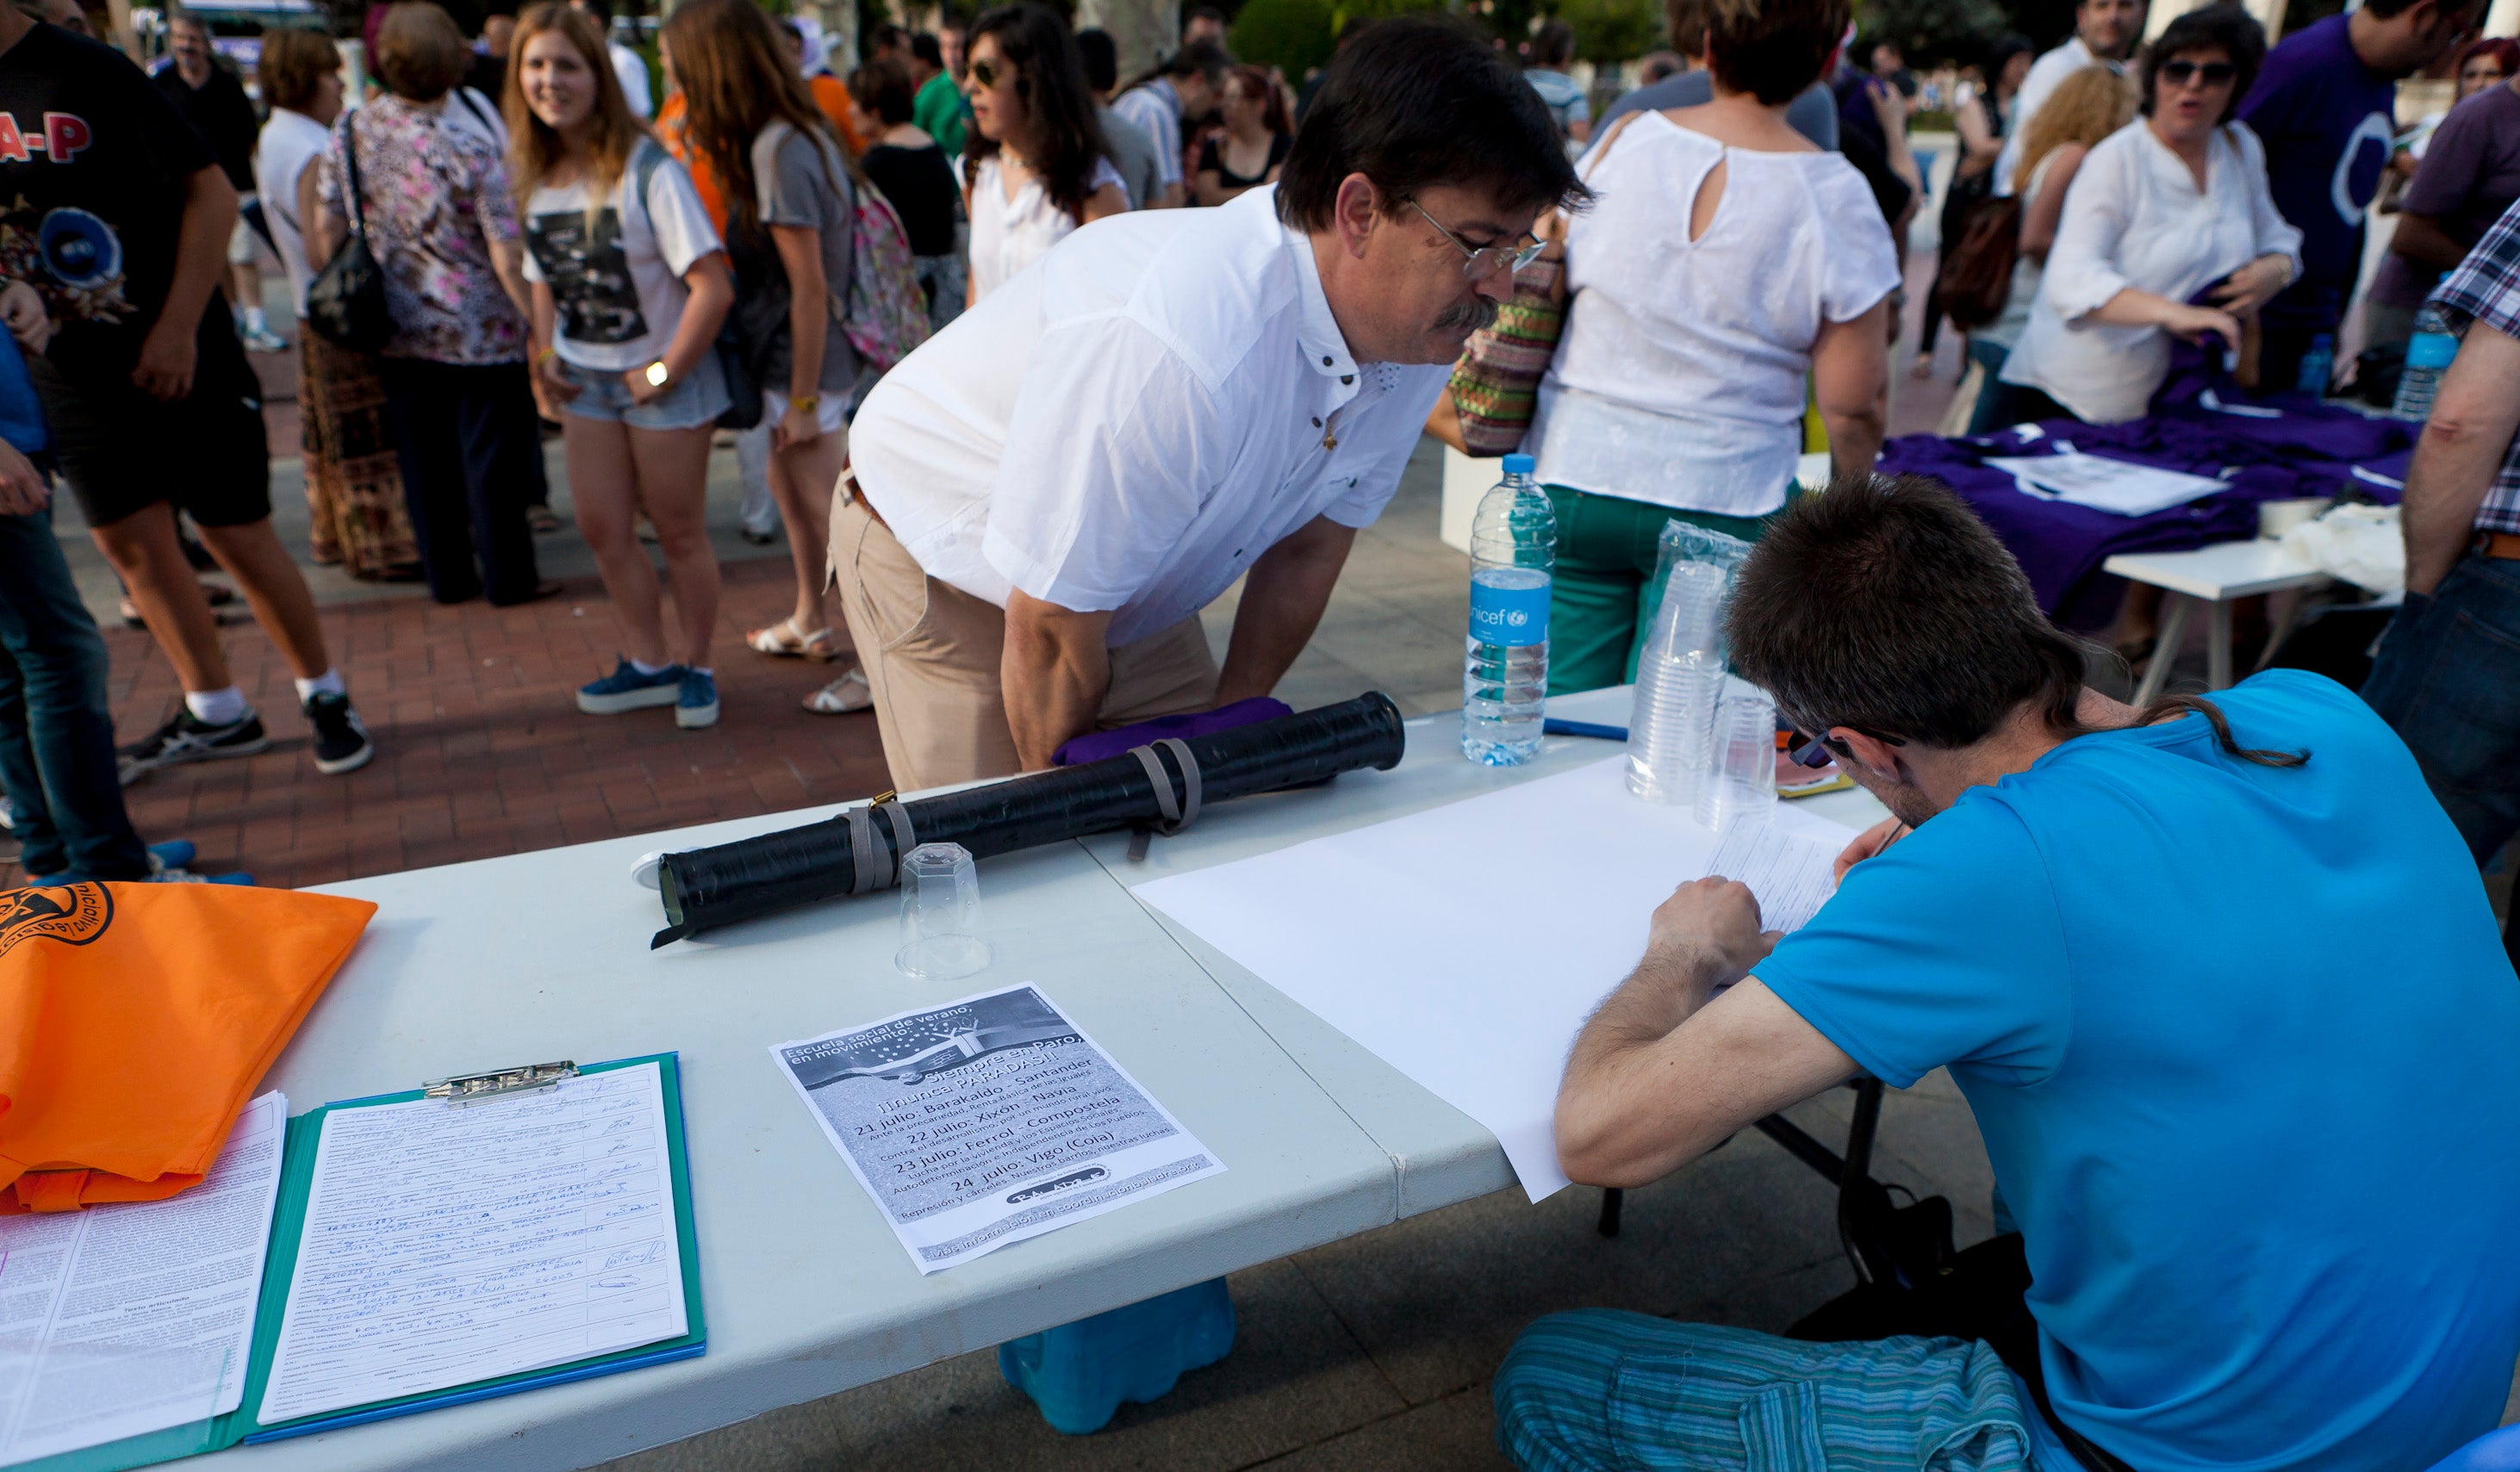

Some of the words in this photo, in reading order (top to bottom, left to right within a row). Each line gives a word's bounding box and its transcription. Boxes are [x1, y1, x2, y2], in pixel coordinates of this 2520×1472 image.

[786, 1040, 844, 1057] Escuela
[848, 1025, 890, 1042] social
[893, 1020, 913, 1028] de
[915, 1007, 972, 1022] verano,
[792, 1055, 812, 1064] en
[815, 1027, 914, 1058] movimiento:
[922, 1053, 1005, 1083] Siempre
[1005, 1047, 1030, 1058] en
[1032, 1033, 1084, 1051] Paro,
[854, 1124, 875, 1135] 21
[879, 1113, 921, 1129] julio:
[924, 1087, 1003, 1113] Barakaldo
[1014, 1059, 1091, 1085] Santander
[954, 1051, 1059, 1089] PARADAS!!
[869, 1130, 893, 1140] Ante
[906, 1108, 965, 1129] precariedad,
[968, 1099, 998, 1109] Renta
[999, 1088, 1029, 1101] Básica
[1057, 1070, 1091, 1082] Iguales.
[880, 1148, 915, 1161] Contra
[929, 1123, 995, 1146] desarrollismo,
[999, 1115, 1015, 1124] por
[1032, 1099, 1066, 1111] mundo
[1067, 1091, 1090, 1101] rural
[1092, 1086, 1111, 1095] vivo.
[893, 1160, 916, 1173] 23
[918, 1150, 963, 1167] julio:
[964, 1127, 1014, 1150] Ferrol
[1027, 1097, 1120, 1127] Compostela
[906, 1131, 929, 1143] 22
[930, 1121, 974, 1138] julio:
[974, 1103, 1020, 1122] Xixón
[1031, 1086, 1076, 1102] Navia
[893, 1158, 992, 1194] Autodeterminación
[1001, 1129, 1073, 1156] Independencia
[1106, 1110, 1144, 1123] Pueblos.
[900, 1199, 955, 1219] Represión
[965, 1179, 1007, 1197] cárceles.
[1011, 1161, 1056, 1178] Nuestros
[1057, 1150, 1096, 1163] barrios,
[1097, 1137, 1138, 1152] nuestras
[1138, 1127, 1173, 1139] luchas.
[907, 1166, 938, 1179] Lucha
[941, 1160, 957, 1170] por
[972, 1140, 1013, 1158] vivienda
[1037, 1119, 1080, 1134] Espacios
[1080, 1108, 1118, 1121] Sociales.
[950, 1177, 974, 1191] 24
[980, 1163, 1025, 1182] julio:
[1025, 1147, 1063, 1163] Vigo
[1066, 1131, 1114, 1151] (Coia)
[932, 1244, 960, 1258] Más
[961, 1216, 1037, 1247] información
[1040, 1209, 1055, 1218] en
[124, 1304, 146, 1314] Texto
[148, 1295, 190, 1309] articulado
